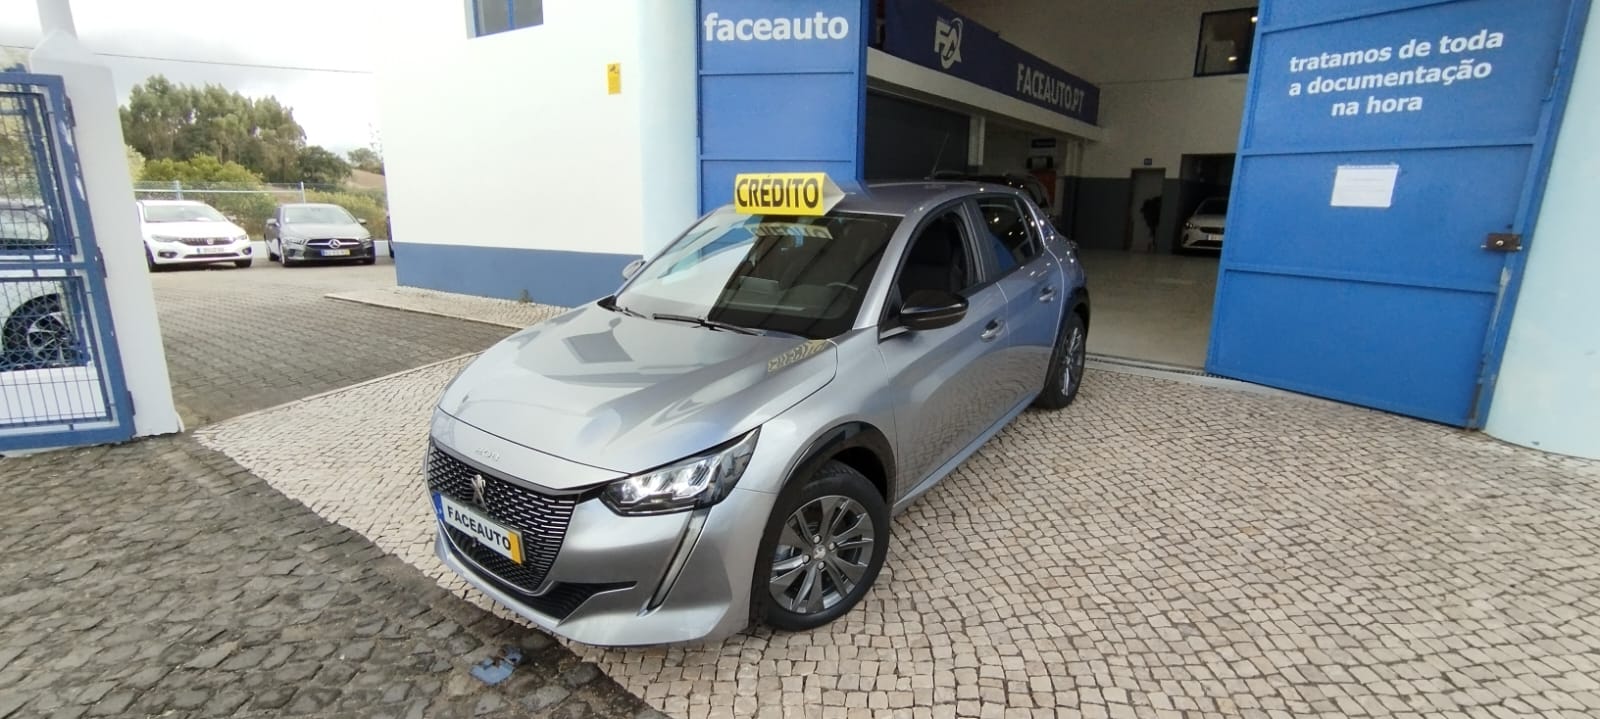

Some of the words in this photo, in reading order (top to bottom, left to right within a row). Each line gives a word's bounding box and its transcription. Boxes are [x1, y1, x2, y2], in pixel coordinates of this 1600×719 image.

[704, 12, 849, 42] faceauto
[1289, 48, 1392, 73] tratamos
[1399, 39, 1431, 59] de
[1439, 29, 1504, 55] toda
[1289, 81, 1301, 97] a
[1307, 59, 1492, 94] documentação
[1331, 100, 1359, 117] na
[1366, 95, 1423, 115] hora
[447, 506, 512, 551] FACEAUTO
